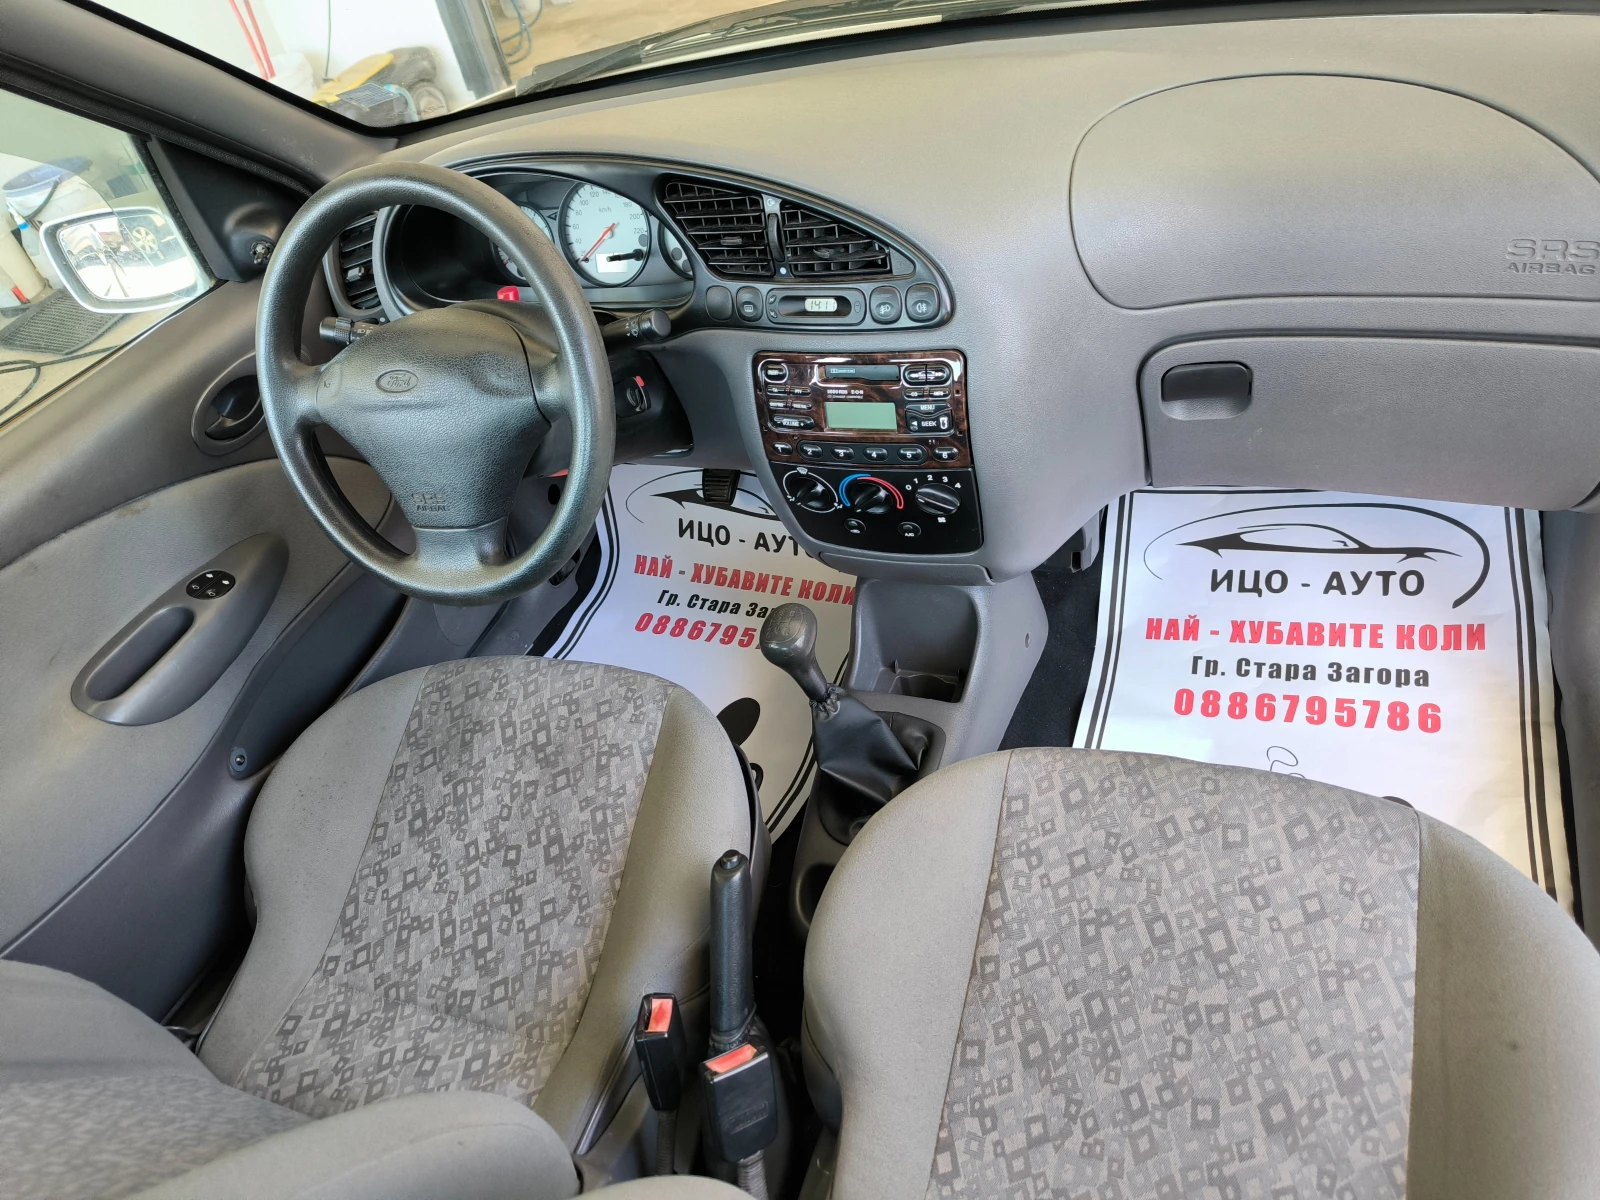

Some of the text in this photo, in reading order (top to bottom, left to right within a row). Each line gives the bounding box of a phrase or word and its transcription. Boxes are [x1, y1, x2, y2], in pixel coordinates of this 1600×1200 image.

[1506, 239, 1600, 261] SRS
[1507, 262, 1596, 275] AIRBAG
[678, 518, 731, 547] ИЦО
[754, 532, 814, 559] АУТ
[634, 554, 674, 578] НАЙ
[690, 563, 794, 597] ХУБАВИТЕ
[797, 579, 856, 606] КОЛИ
[1210, 568, 1289, 598] ИЦО
[1323, 569, 1425, 597] АУТО
[657, 589, 680, 607] Гр.
[686, 594, 741, 615] Стара
[634, 612, 761, 650] 0886795
[1145, 614, 1200, 642] НАЙ
[1229, 620, 1384, 649] ХУБАВИТЕ
[1396, 623, 1486, 651] КОЛИ
[1191, 655, 1430, 688] Гр. Стара Загора
[1173, 688, 1442, 733] 0886795786
